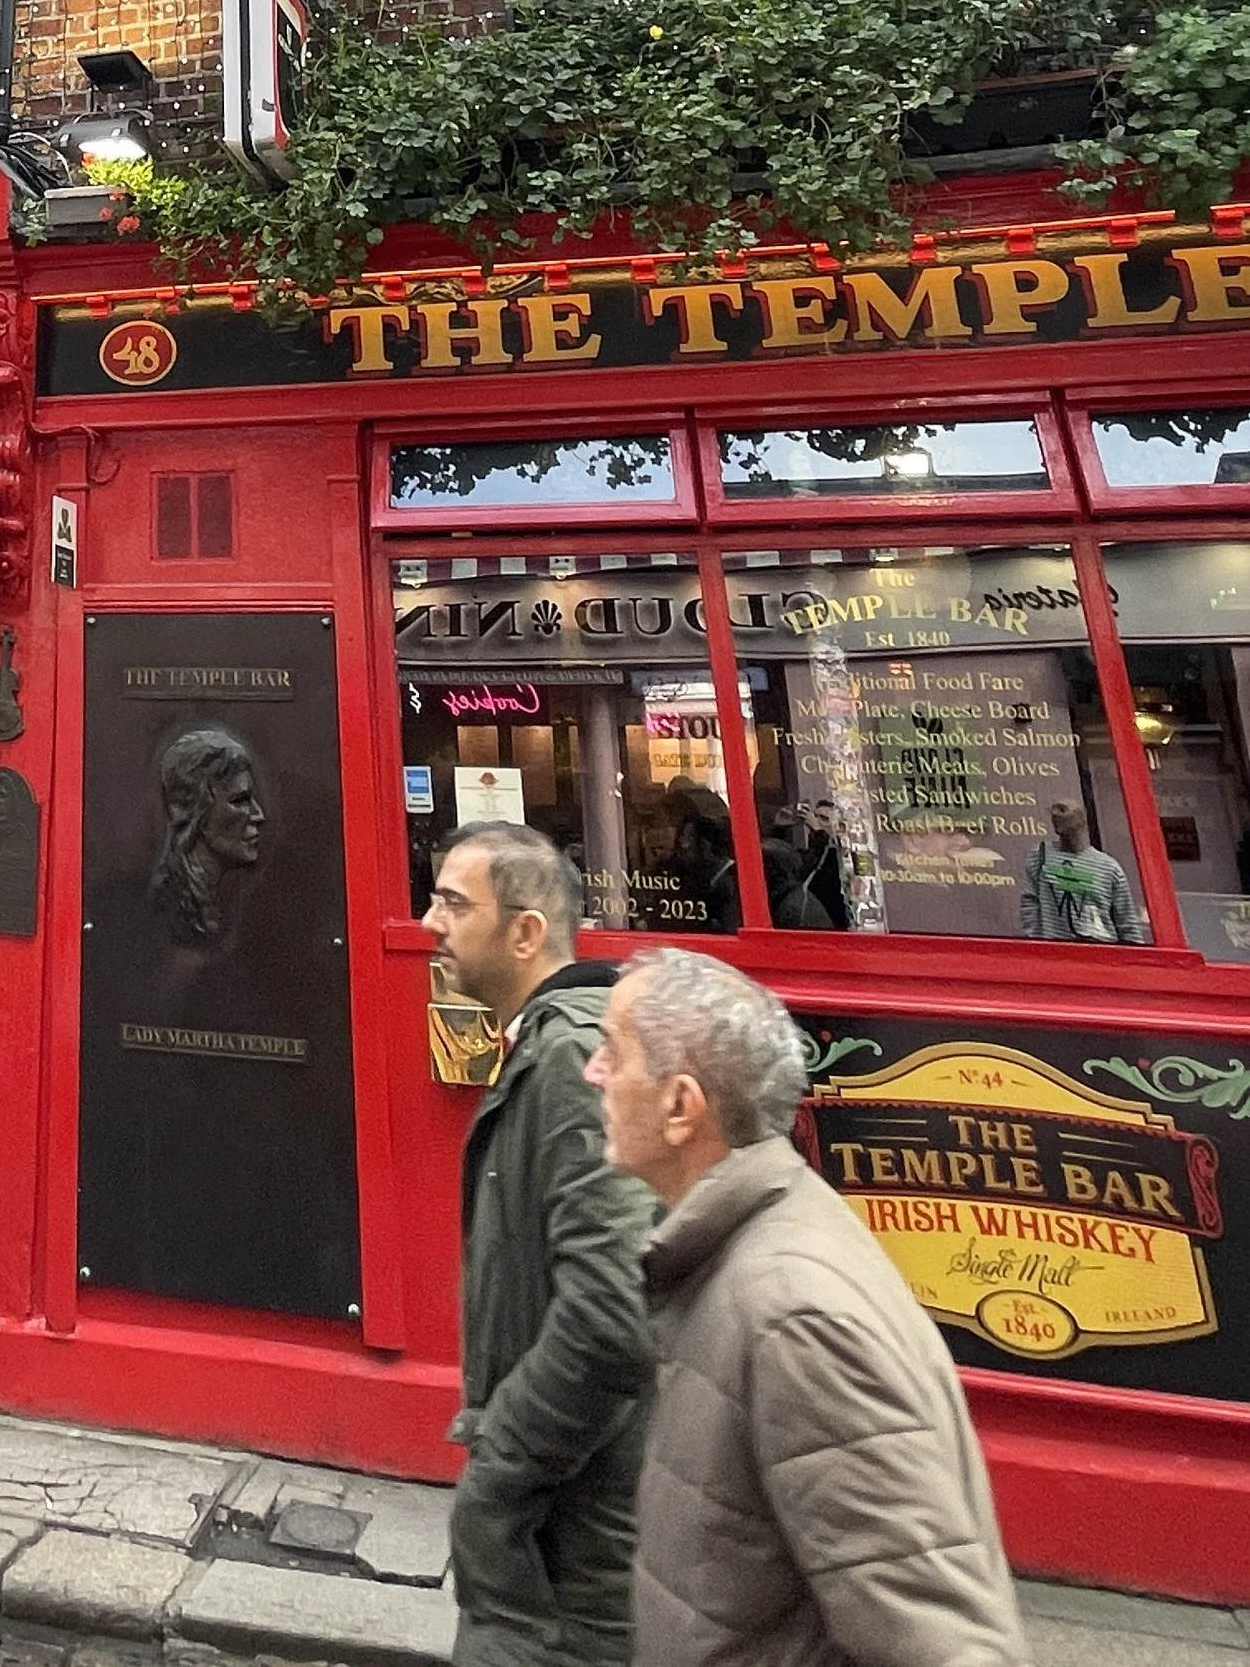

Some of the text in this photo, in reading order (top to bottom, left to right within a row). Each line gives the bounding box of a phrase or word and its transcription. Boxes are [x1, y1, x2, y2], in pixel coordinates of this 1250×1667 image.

[328, 244, 1250, 374] THE TEMPLE
[112, 335, 160, 375] 48
[869, 568, 917, 588] The
[780, 594, 1031, 636] TEMPLE BAR
[907, 630, 951, 647] 1840
[127, 668, 292, 688] THE TEMPLE BAR
[922, 672, 974, 691] Food
[980, 672, 1025, 691] Fare
[910, 700, 984, 720] Cheese
[988, 701, 1051, 721] Board
[772, 727, 825, 747] Fresh
[914, 727, 998, 747] Smoked
[1002, 728, 1082, 748] Salmon
[992, 756, 1062, 778] Olives
[914, 785, 1037, 806] Sandwiches
[876, 814, 930, 833] Roast
[993, 817, 1049, 837] Rolls
[620, 869, 681, 891] Music
[592, 897, 639, 918] 2002
[660, 898, 708, 921] 2023
[123, 1025, 165, 1044] LADY
[238, 1033, 308, 1056] TEMPLE
[948, 1115, 1040, 1153] THE
[830, 1142, 1185, 1221] TEMPLE BAR
[865, 1198, 1161, 1264] IRISH WHISKEY
[946, 1236, 1105, 1295] Single Malt
[1105, 1305, 1178, 1325] IRELAND
[1002, 1315, 1056, 1343] 1840
